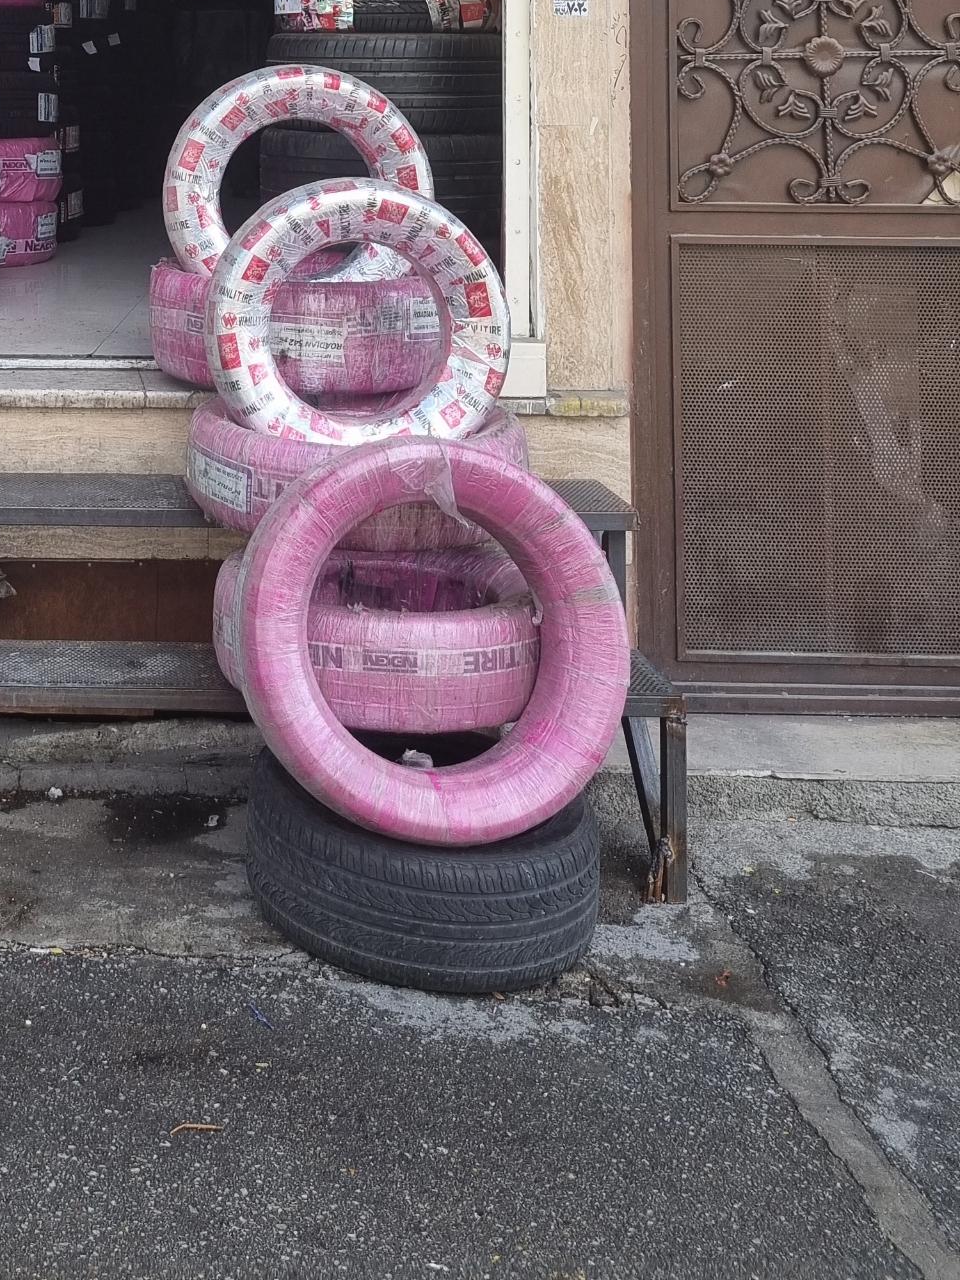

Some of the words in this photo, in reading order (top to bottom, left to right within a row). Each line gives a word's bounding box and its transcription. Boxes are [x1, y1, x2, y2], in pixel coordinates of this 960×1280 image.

[197, 125, 230, 150] WANLITIRE
[288, 214, 315, 247] WANLITIRE
[217, 286, 254, 305] WANLITIRE
[304, 340, 343, 351] ROADIAN
[241, 391, 276, 419] WANLITIRE
[362, 648, 418, 674] NEXEN
[463, 645, 519, 675] TIRE
